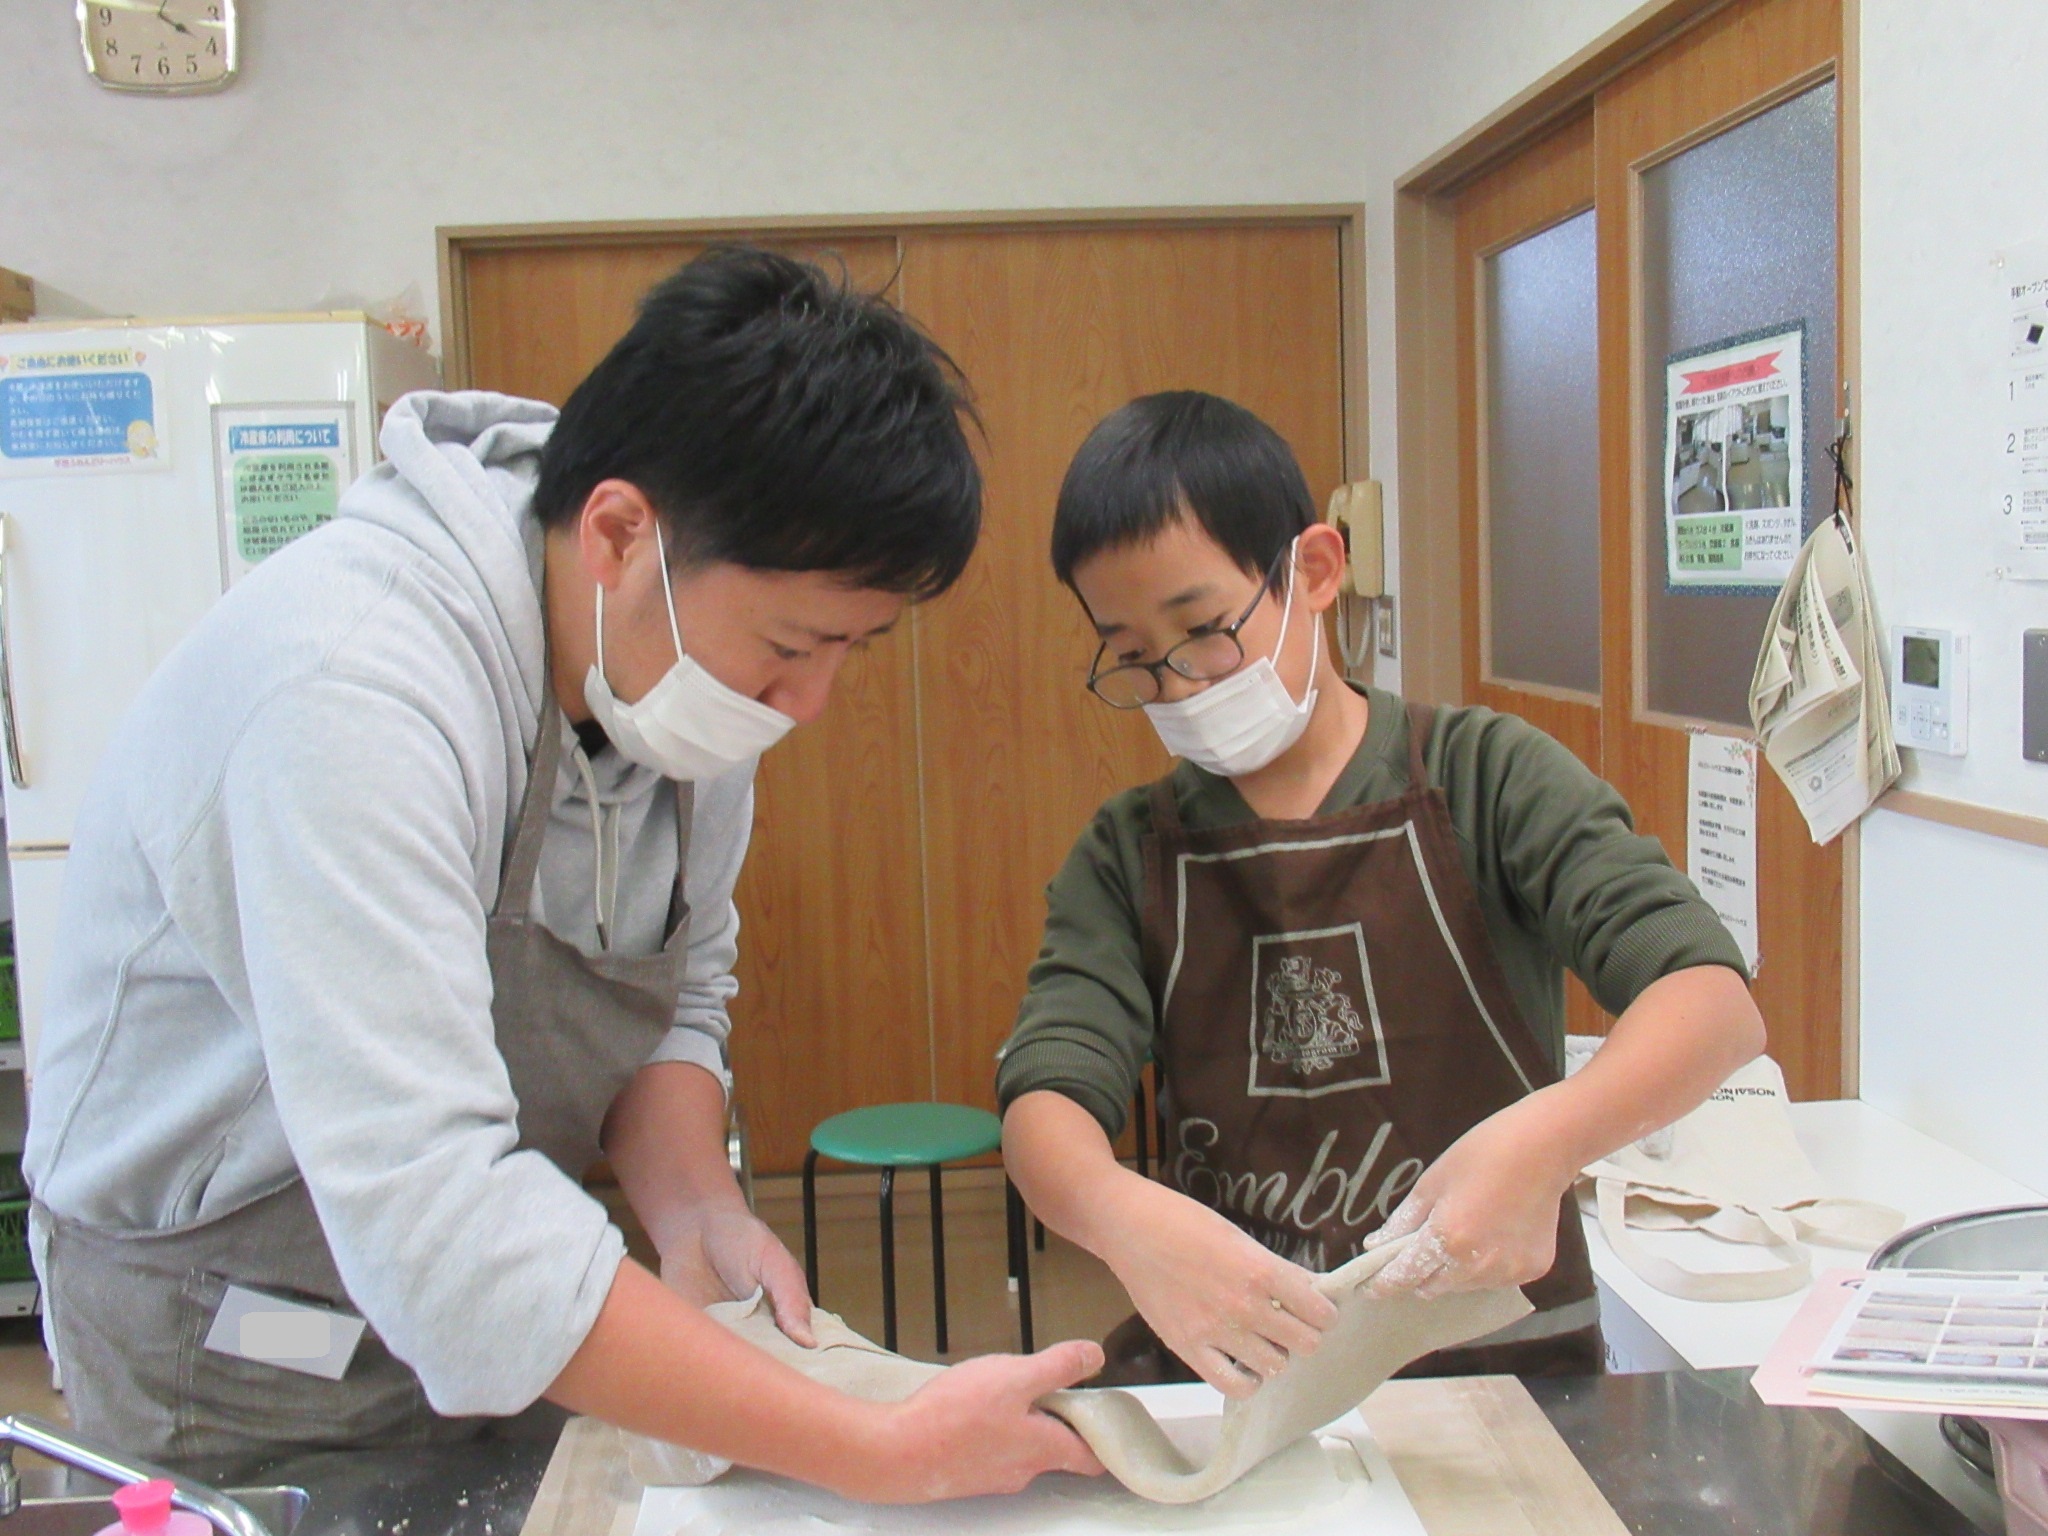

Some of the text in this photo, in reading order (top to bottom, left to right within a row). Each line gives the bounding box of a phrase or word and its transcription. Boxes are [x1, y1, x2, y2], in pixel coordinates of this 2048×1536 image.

[100, 8, 112, 27] 9
[105, 38, 118, 57] 8
[205, 36, 217, 56] 4
[130, 54, 142, 75] 7
[157, 57, 170, 76] 6
[186, 54, 198, 75] 5
[2006, 432, 2017, 454] 2
[2003, 494, 2013, 515] 3
[1735, 1087, 1776, 1097] NOSAI
